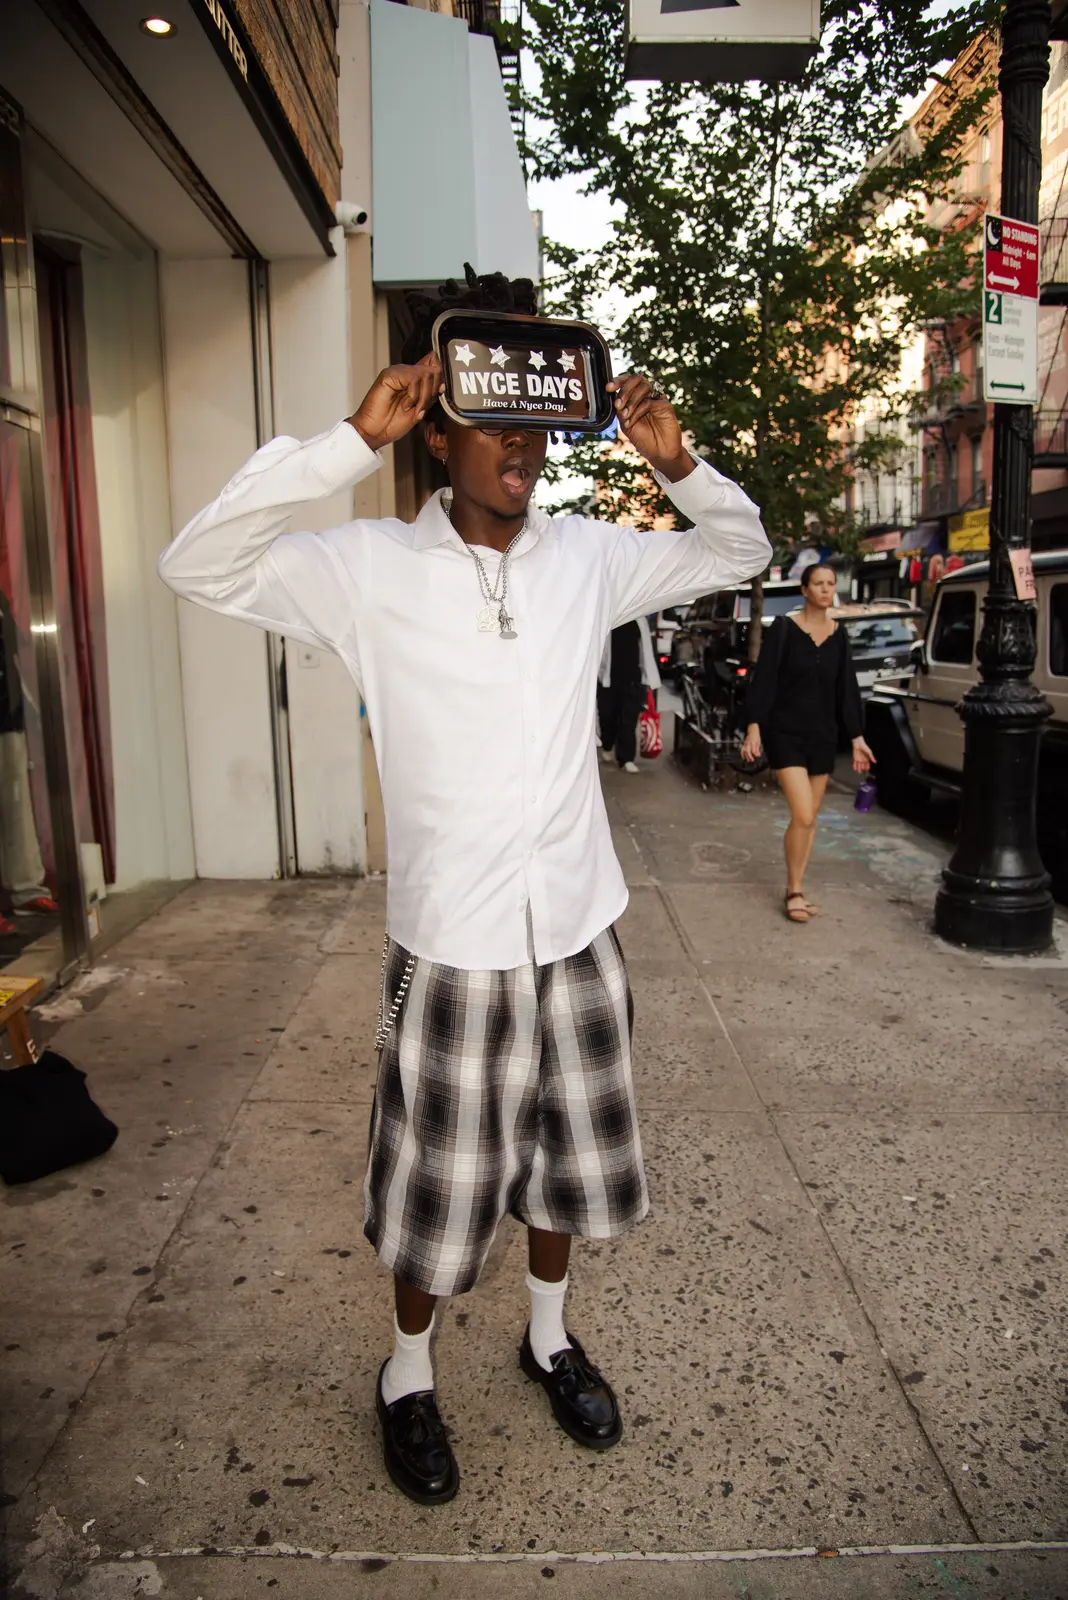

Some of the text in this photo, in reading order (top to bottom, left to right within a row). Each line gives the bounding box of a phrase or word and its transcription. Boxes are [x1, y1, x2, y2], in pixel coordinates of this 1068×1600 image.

[1002, 226, 1037, 246] NO STANDING
[1009, 257, 1021, 270] Days
[988, 293, 999, 322] 2
[458, 371, 583, 401] NYCE DAYS
[483, 398, 567, 412] Have A Nyce Day.
